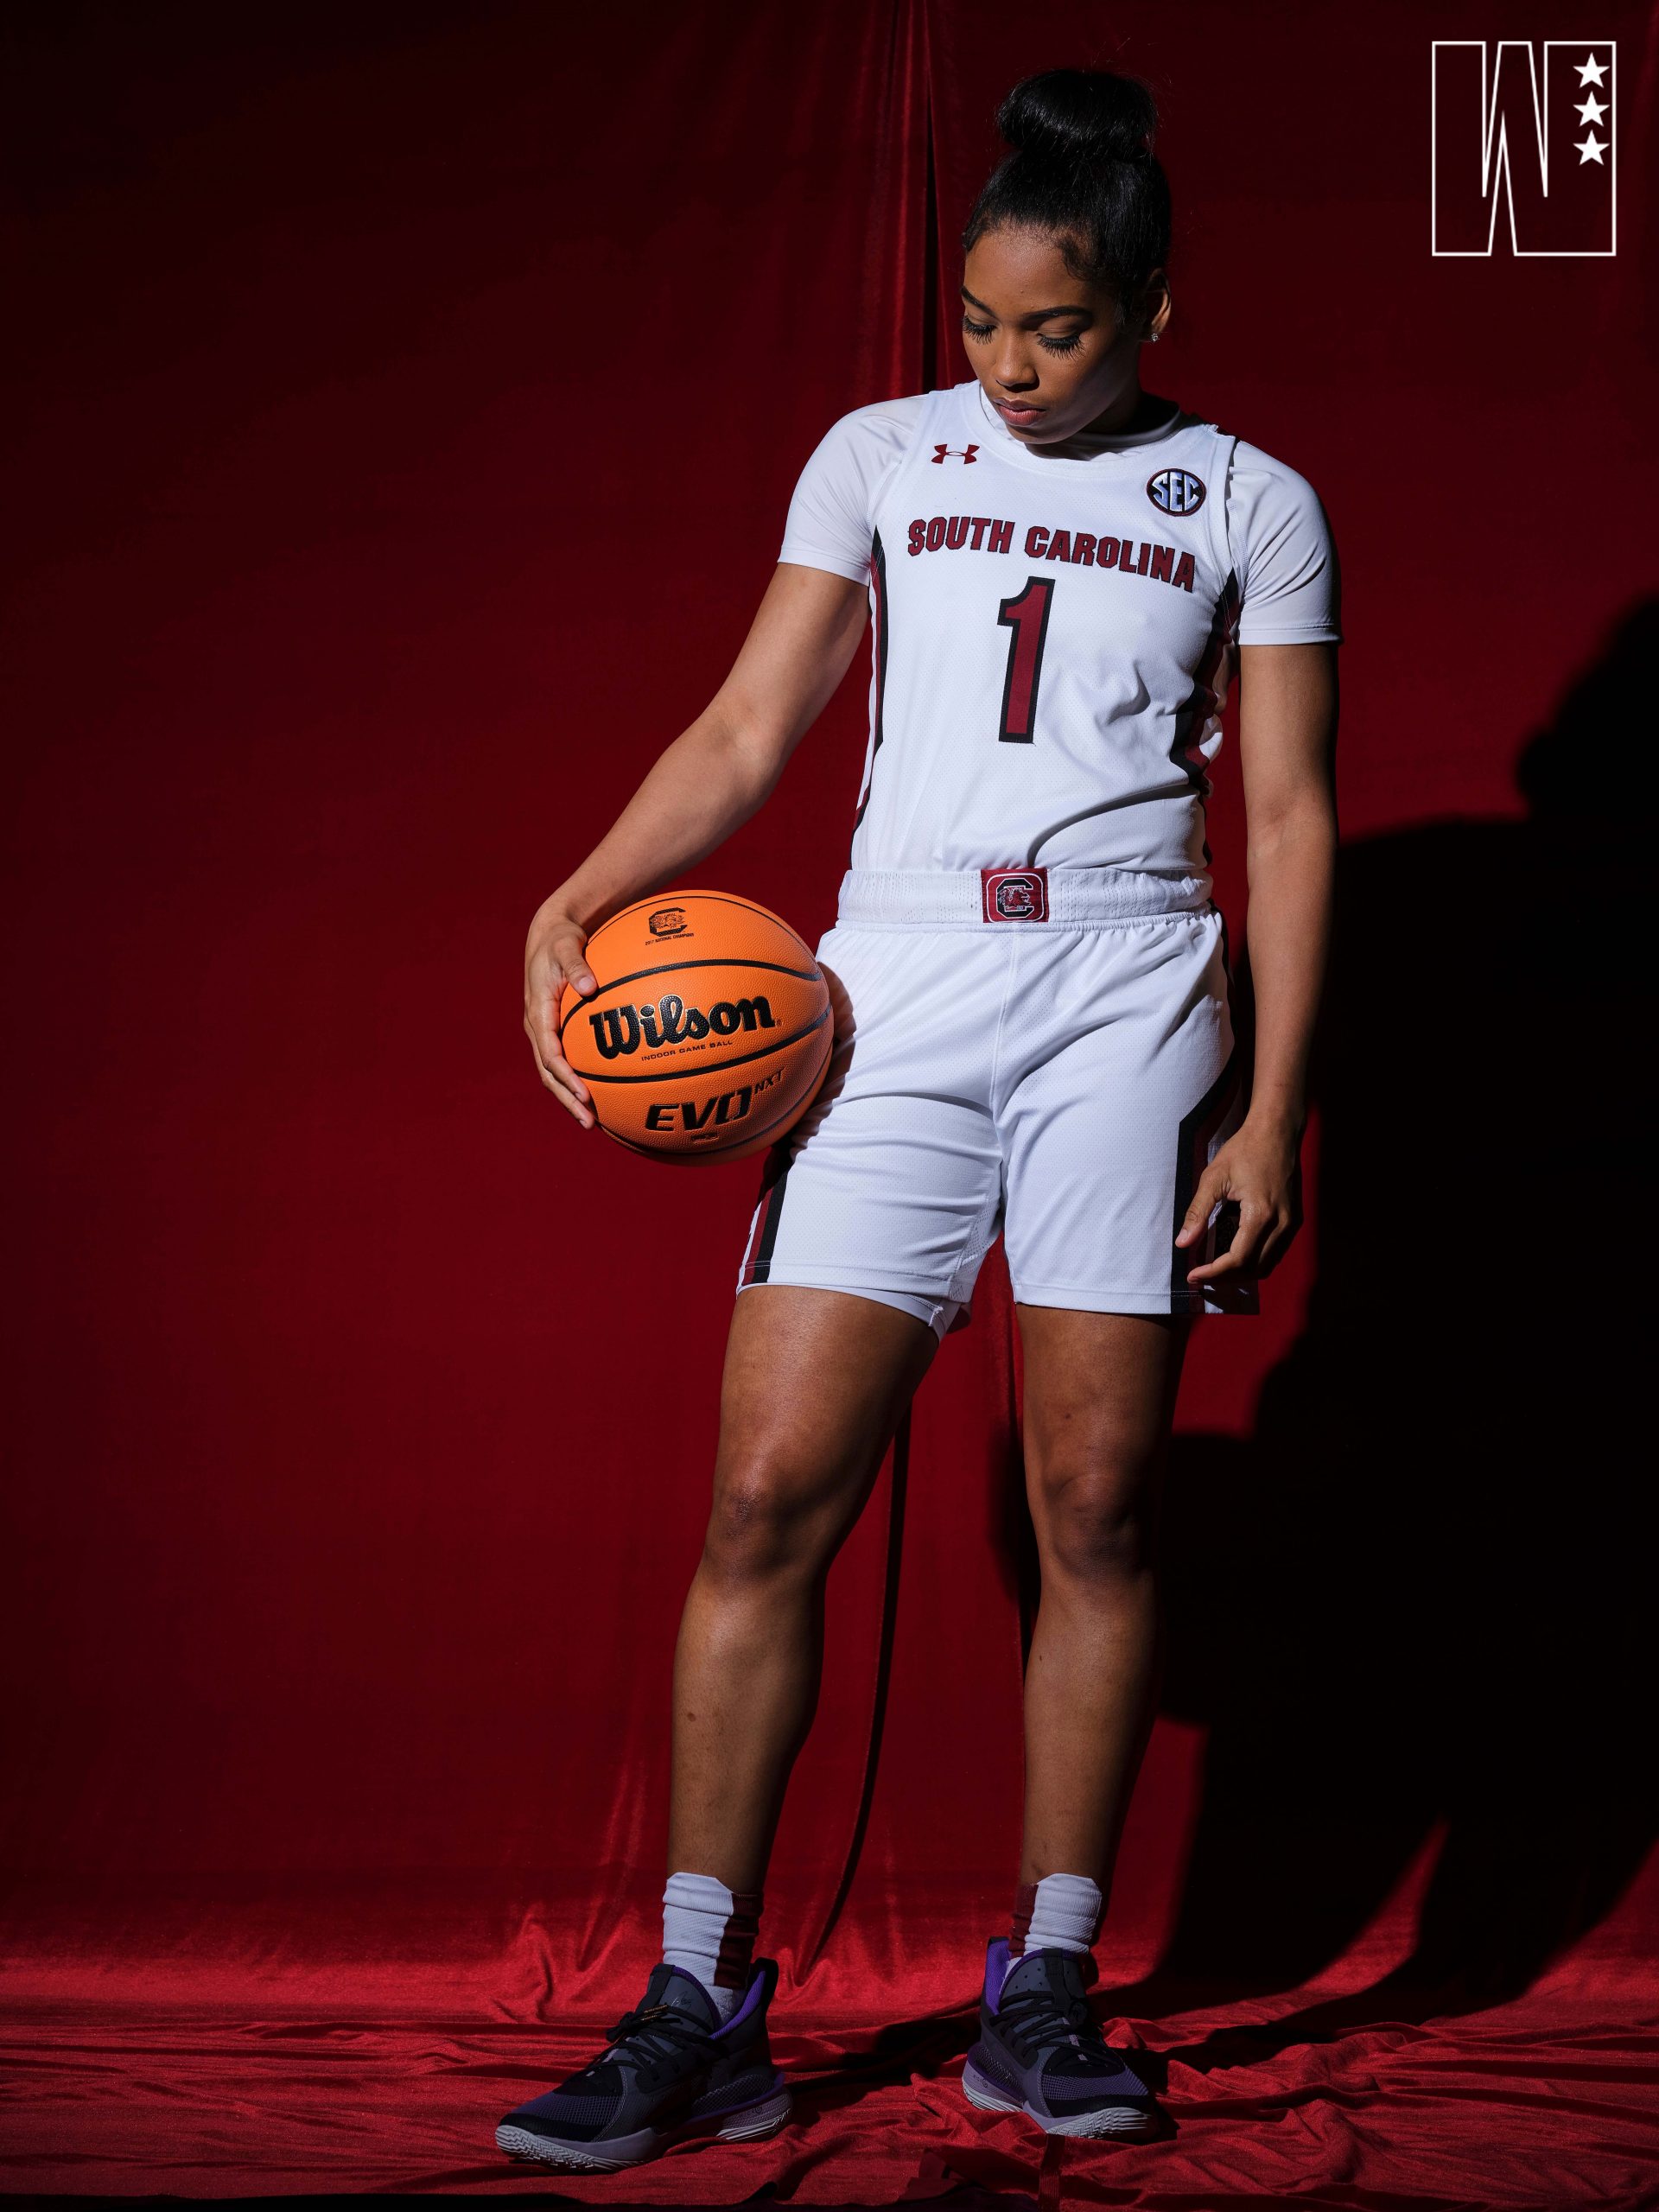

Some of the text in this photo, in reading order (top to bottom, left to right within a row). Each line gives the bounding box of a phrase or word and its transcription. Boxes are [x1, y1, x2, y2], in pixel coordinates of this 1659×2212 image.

[1151, 471, 1200, 512] SEC
[908, 517, 1196, 593] SOUTH CAROLINA
[997, 575, 1056, 744] 1
[589, 995, 776, 1059] Wilson
[641, 1040, 733, 1062] INDOOR GAME BALL
[645, 1068, 784, 1131] EVO NXT
